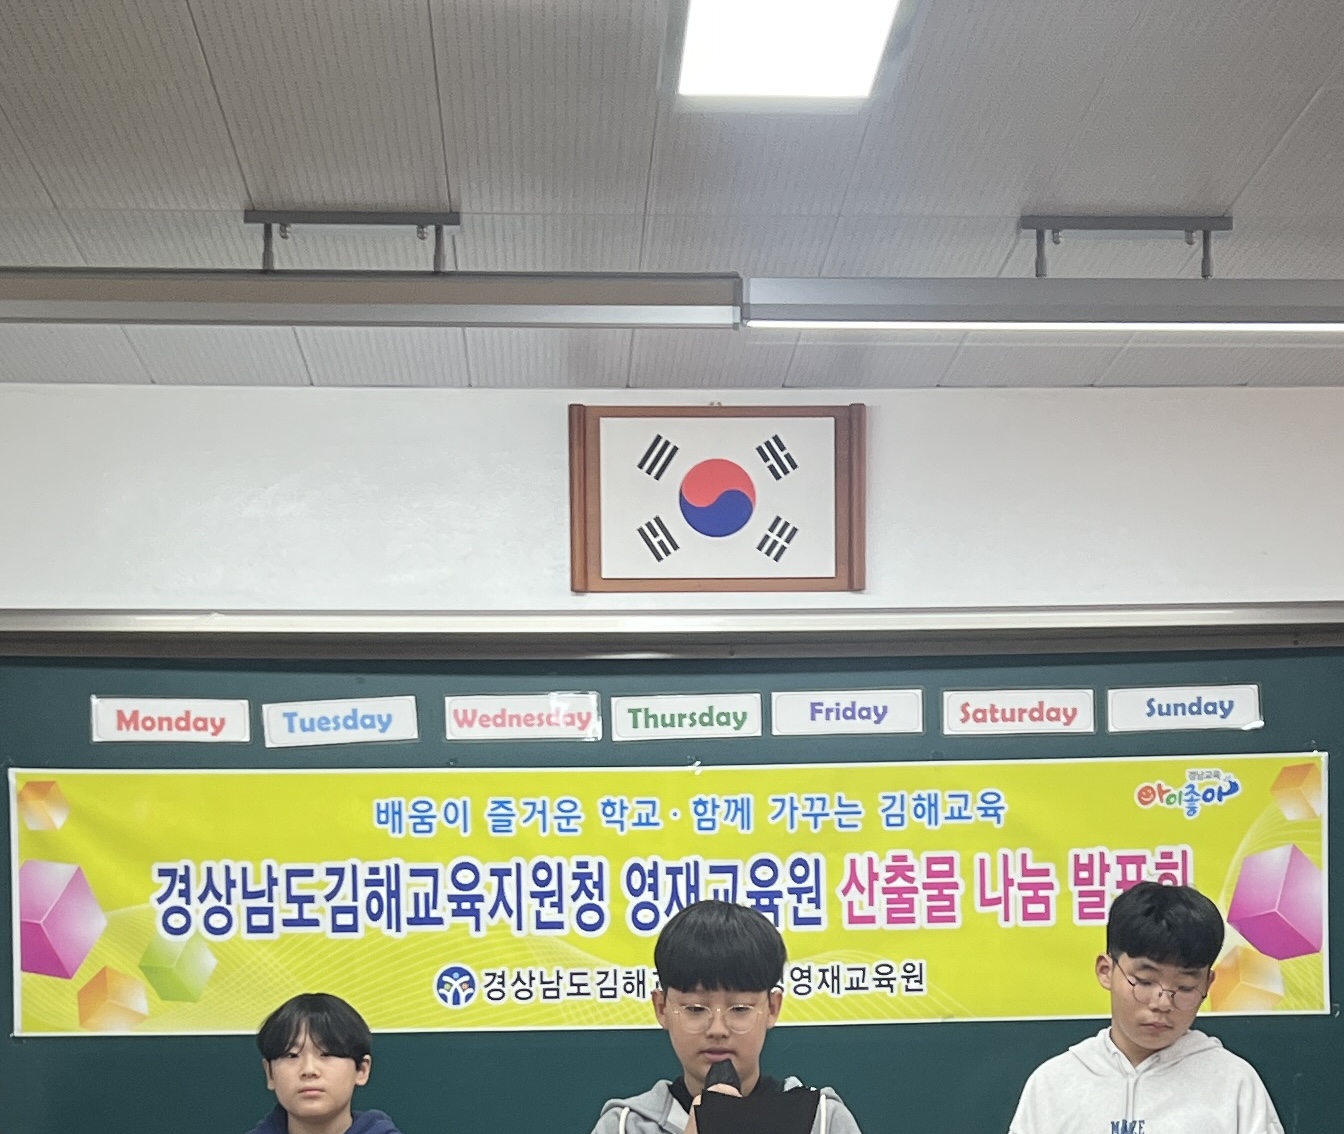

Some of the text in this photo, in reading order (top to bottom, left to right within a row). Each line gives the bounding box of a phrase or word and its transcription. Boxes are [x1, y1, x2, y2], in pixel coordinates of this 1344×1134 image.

[282, 707, 393, 734] Tuesday
[627, 706, 748, 731] Thursday
[809, 700, 889, 725] Friday
[960, 701, 1078, 727] Saturday
[1145, 696, 1235, 721] Sunday
[115, 709, 226, 737] Monday
[1138, 780, 1239, 817] 아이좋아
[375, 799, 468, 835] 배움이
[487, 798, 583, 834] 즐거운
[770, 795, 862, 830] 가꾸는
[881, 791, 1006, 828] 김해교육
[155, 858, 608, 937] 경상남도김해교육지원청
[625, 856, 823, 932] 영재교육원
[841, 854, 959, 926] 산출물
[977, 850, 1057, 923] 나눔
